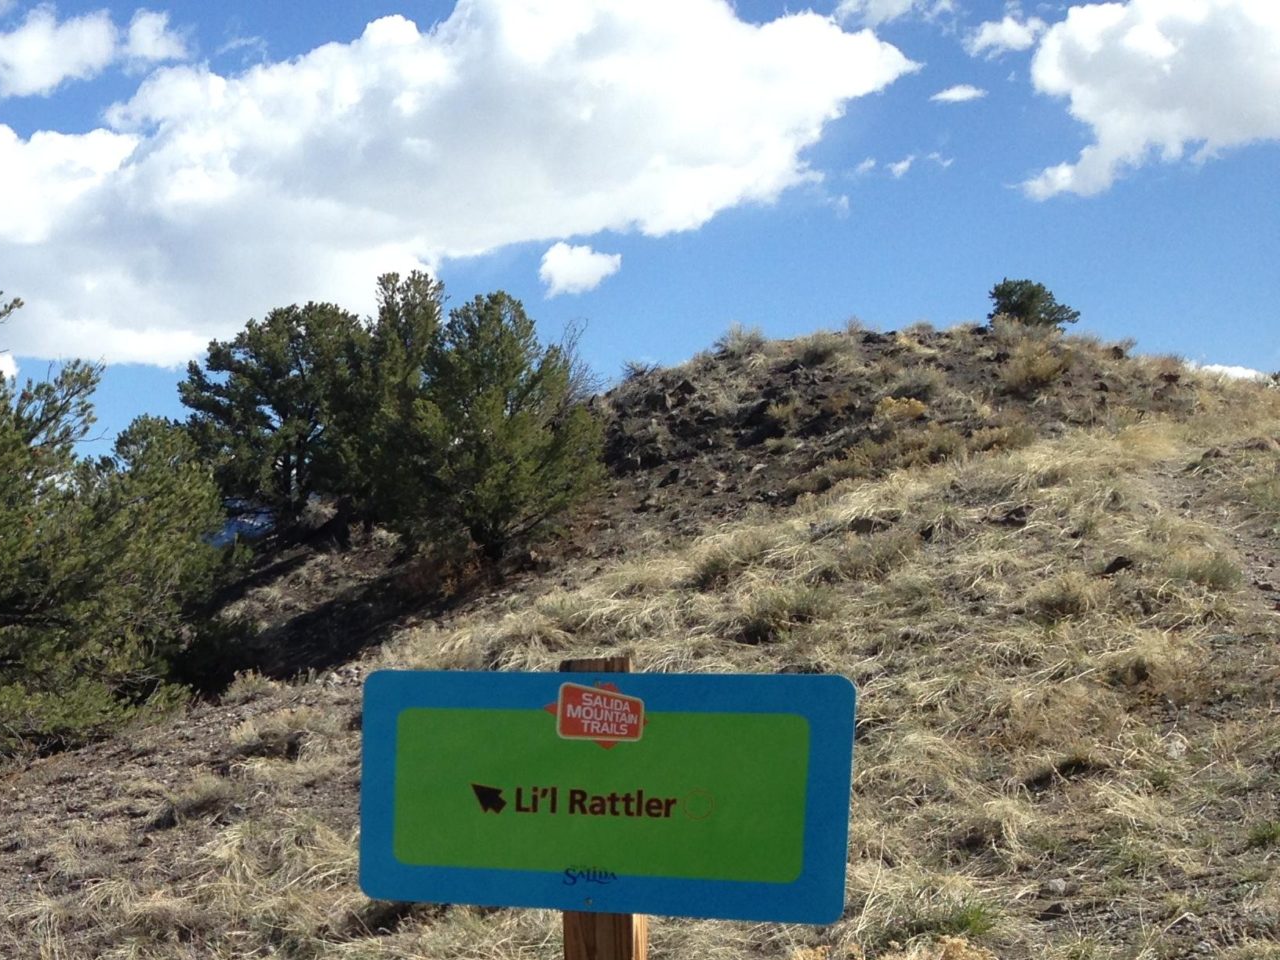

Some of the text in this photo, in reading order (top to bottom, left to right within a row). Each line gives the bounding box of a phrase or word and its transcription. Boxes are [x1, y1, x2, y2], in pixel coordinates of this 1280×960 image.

[581, 692, 631, 713] SALIDA
[566, 703, 638, 725] MOUNTAIN
[581, 719, 629, 735] TRAILS
[515, 786, 677, 817] Li'l Rattler
